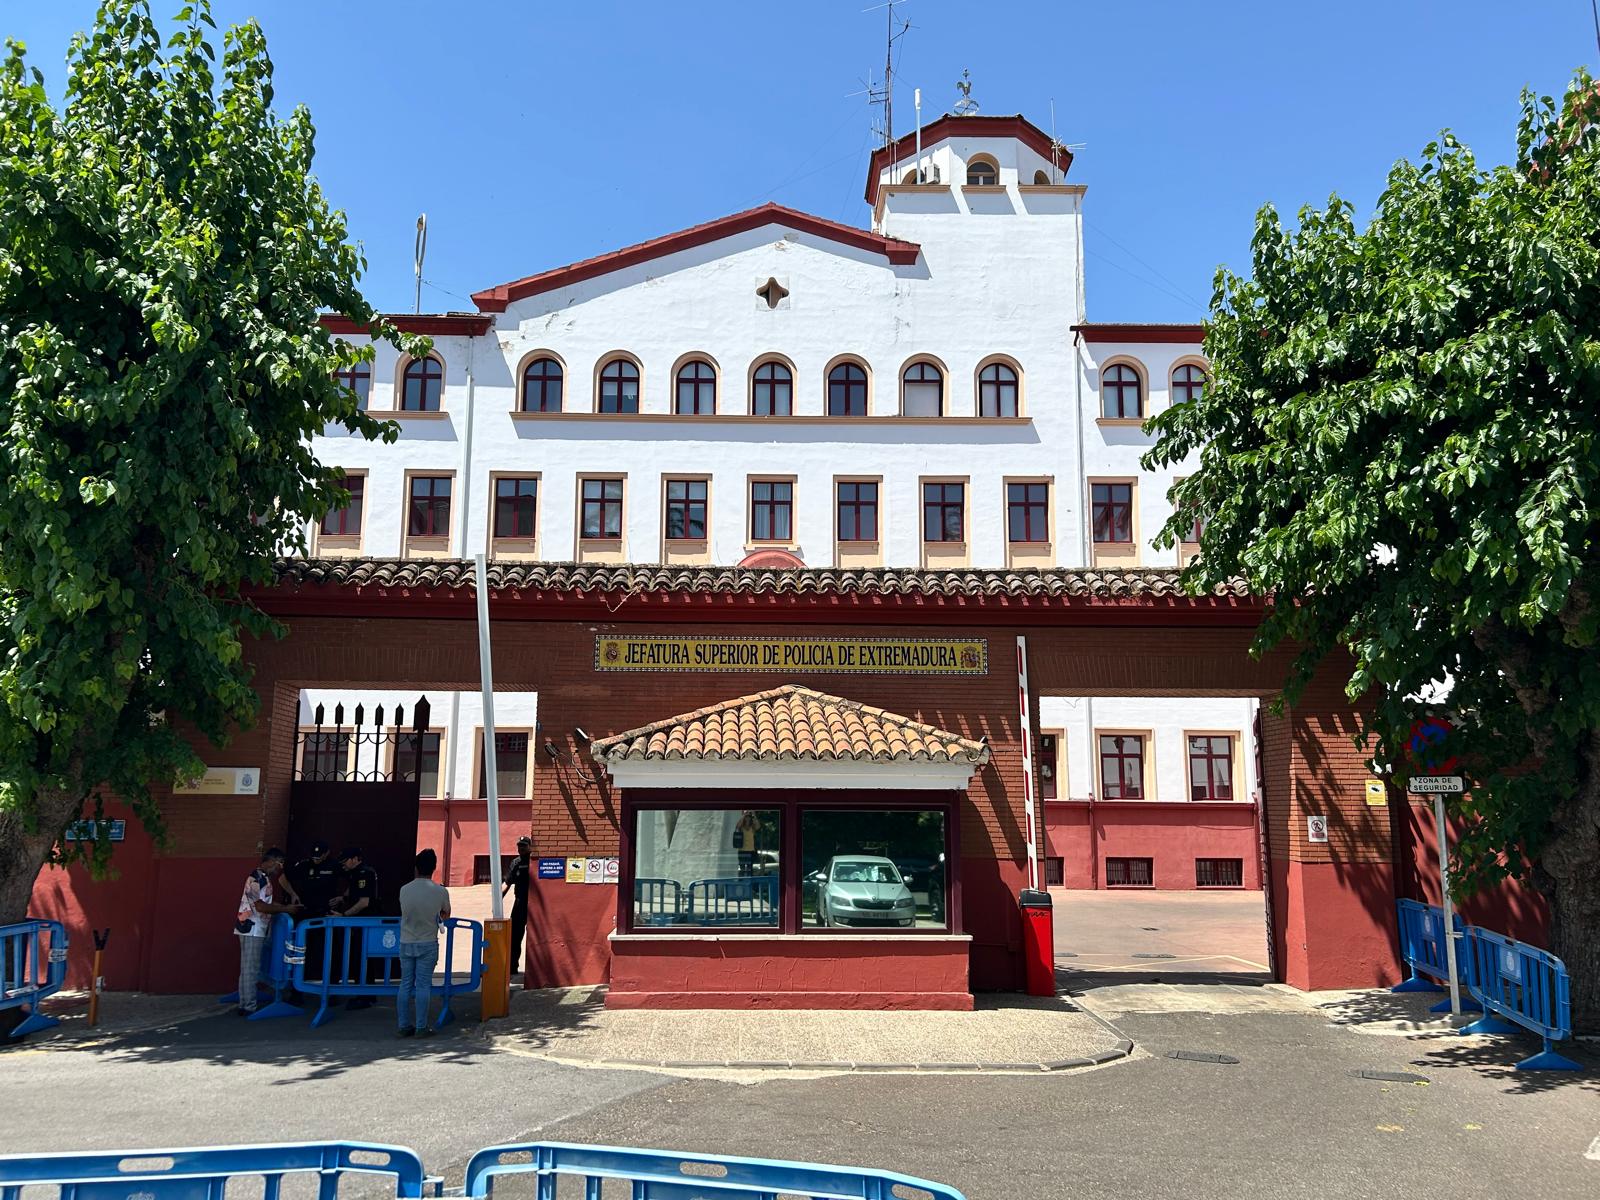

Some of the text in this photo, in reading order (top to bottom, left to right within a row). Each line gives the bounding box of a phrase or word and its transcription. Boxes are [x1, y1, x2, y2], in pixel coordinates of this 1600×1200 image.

[624, 643, 958, 667] JEFATURA SUPERIOR DE POLICIA DE EXTREMADURA
